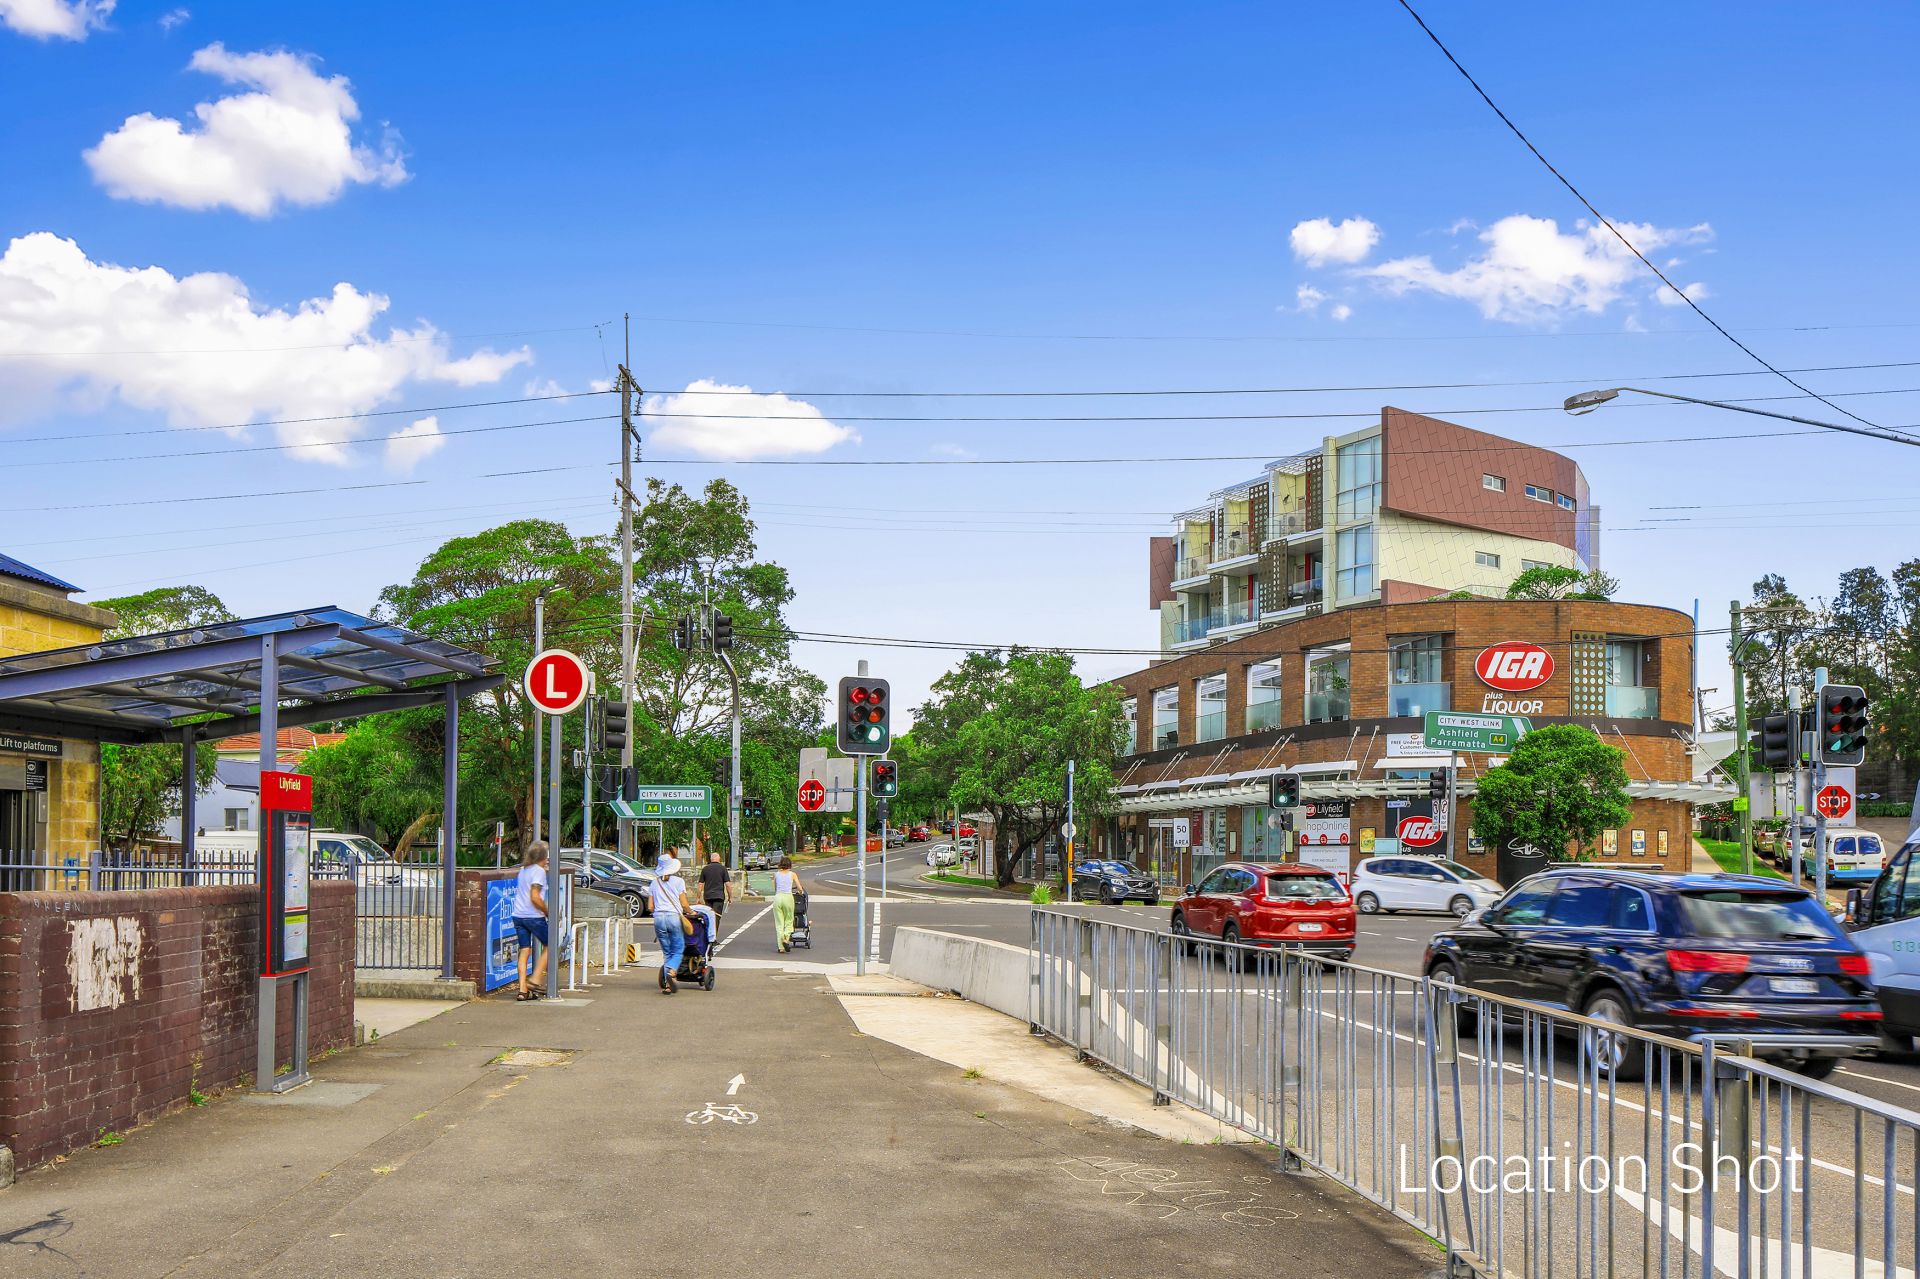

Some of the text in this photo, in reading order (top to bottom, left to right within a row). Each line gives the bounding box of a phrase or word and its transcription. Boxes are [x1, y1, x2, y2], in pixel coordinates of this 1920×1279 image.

[1484, 651, 1546, 679] IGA
[546, 663, 568, 699] L
[1485, 692, 1504, 701] plus
[1482, 700, 1544, 714] LIQUOR
[1439, 717, 1456, 725] CITY
[1438, 728, 1479, 738] Ashfield
[0, 737, 58, 752] Lift to platforms
[1430, 738, 1486, 749] Parramatta
[279, 776, 301, 792] Lilyfield
[800, 789, 823, 801] STOP
[1819, 795, 1849, 808] STOP
[665, 804, 701, 814] Sydney
[1317, 804, 1344, 816] Lilyfield
[1176, 825, 1187, 833] 50
[1306, 821, 1348, 832] hopOnline
[1401, 822, 1436, 839] IGA
